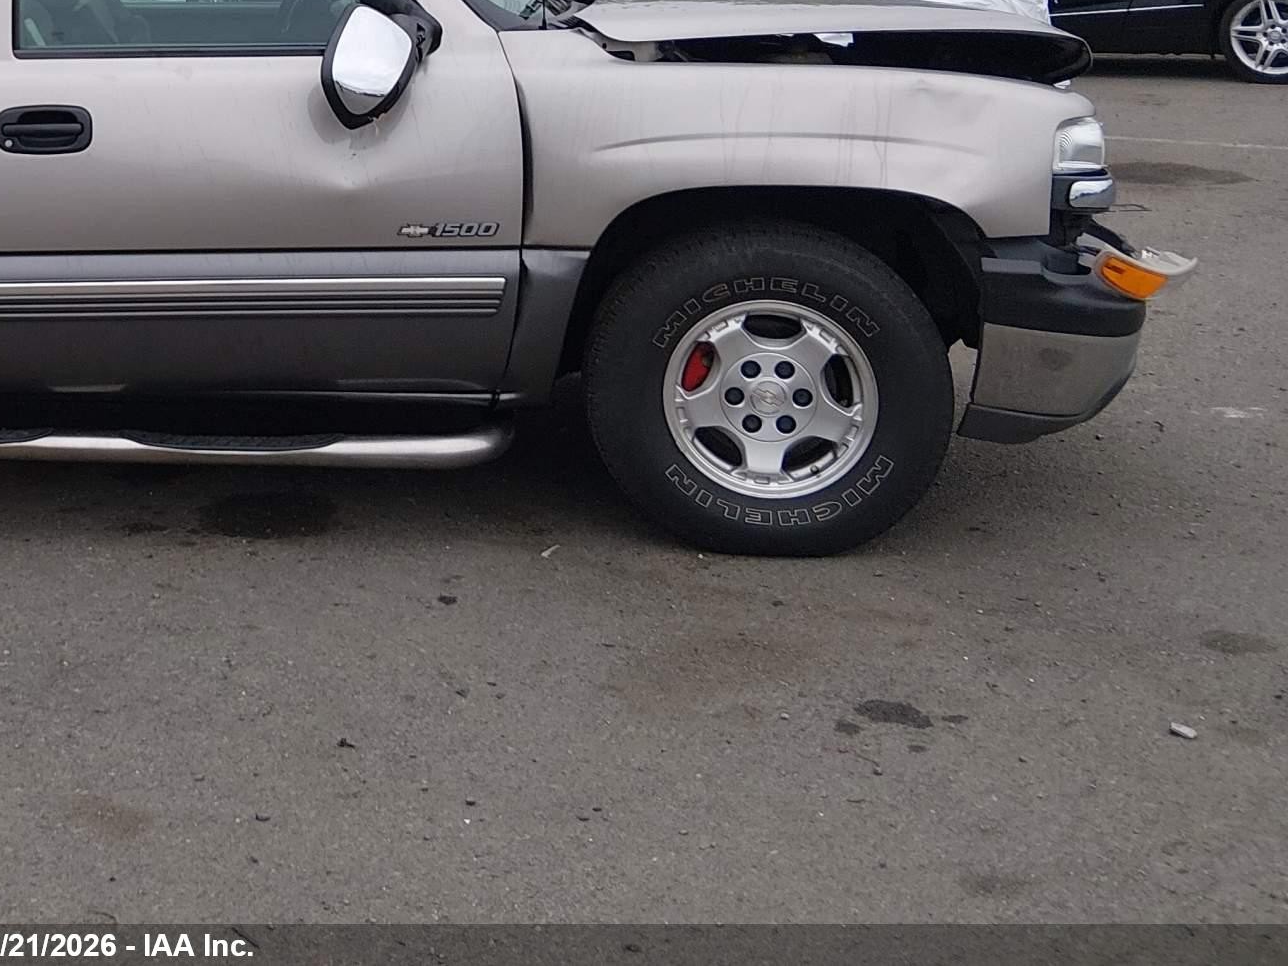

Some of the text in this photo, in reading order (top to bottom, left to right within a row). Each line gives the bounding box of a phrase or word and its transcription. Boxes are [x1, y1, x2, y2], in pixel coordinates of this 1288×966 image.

[433, 222, 500, 237] 1500
[652, 277, 880, 348] MICHELIN
[664, 455, 894, 526] MICHELIN
